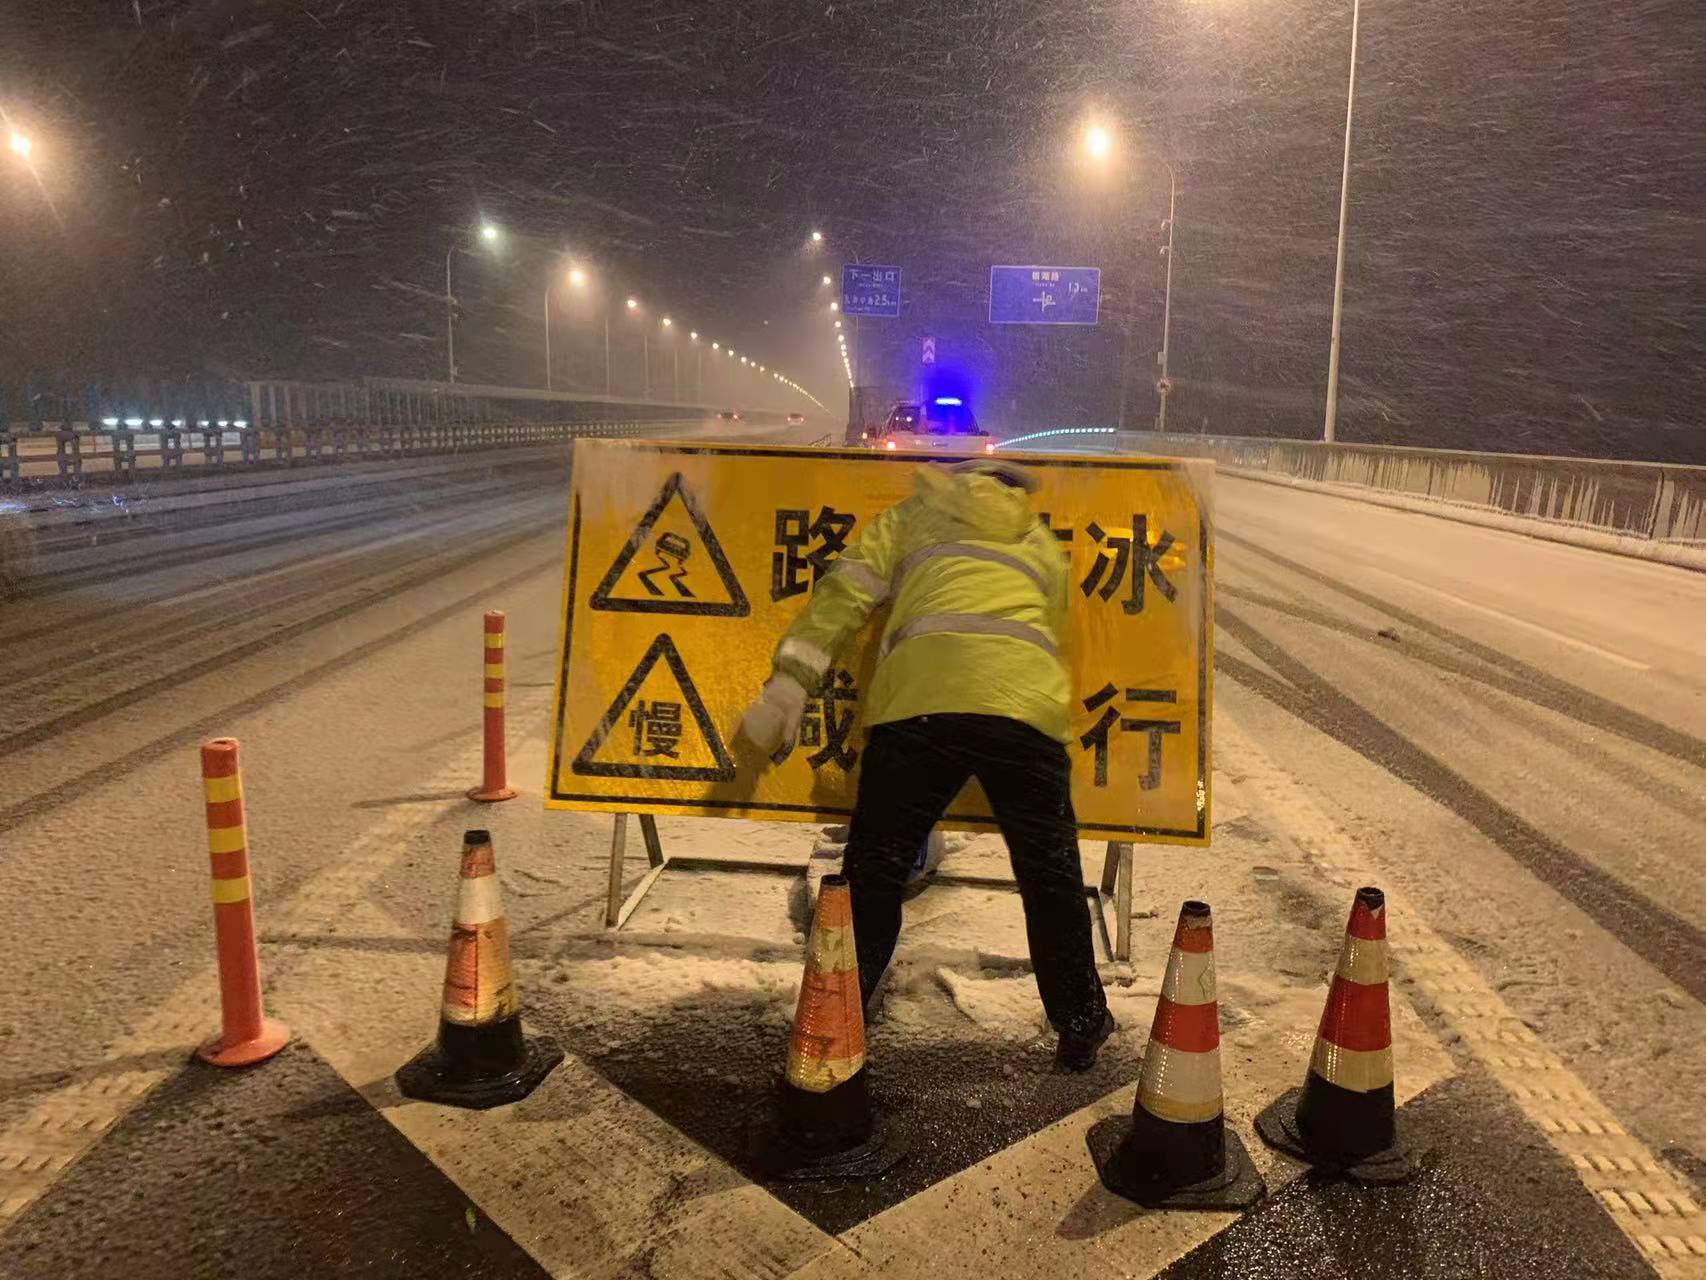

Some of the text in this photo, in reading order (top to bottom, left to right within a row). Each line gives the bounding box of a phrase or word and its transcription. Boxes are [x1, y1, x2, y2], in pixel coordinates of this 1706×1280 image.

[848, 268, 895, 282] 下一出口
[628, 699, 683, 759] 慢
